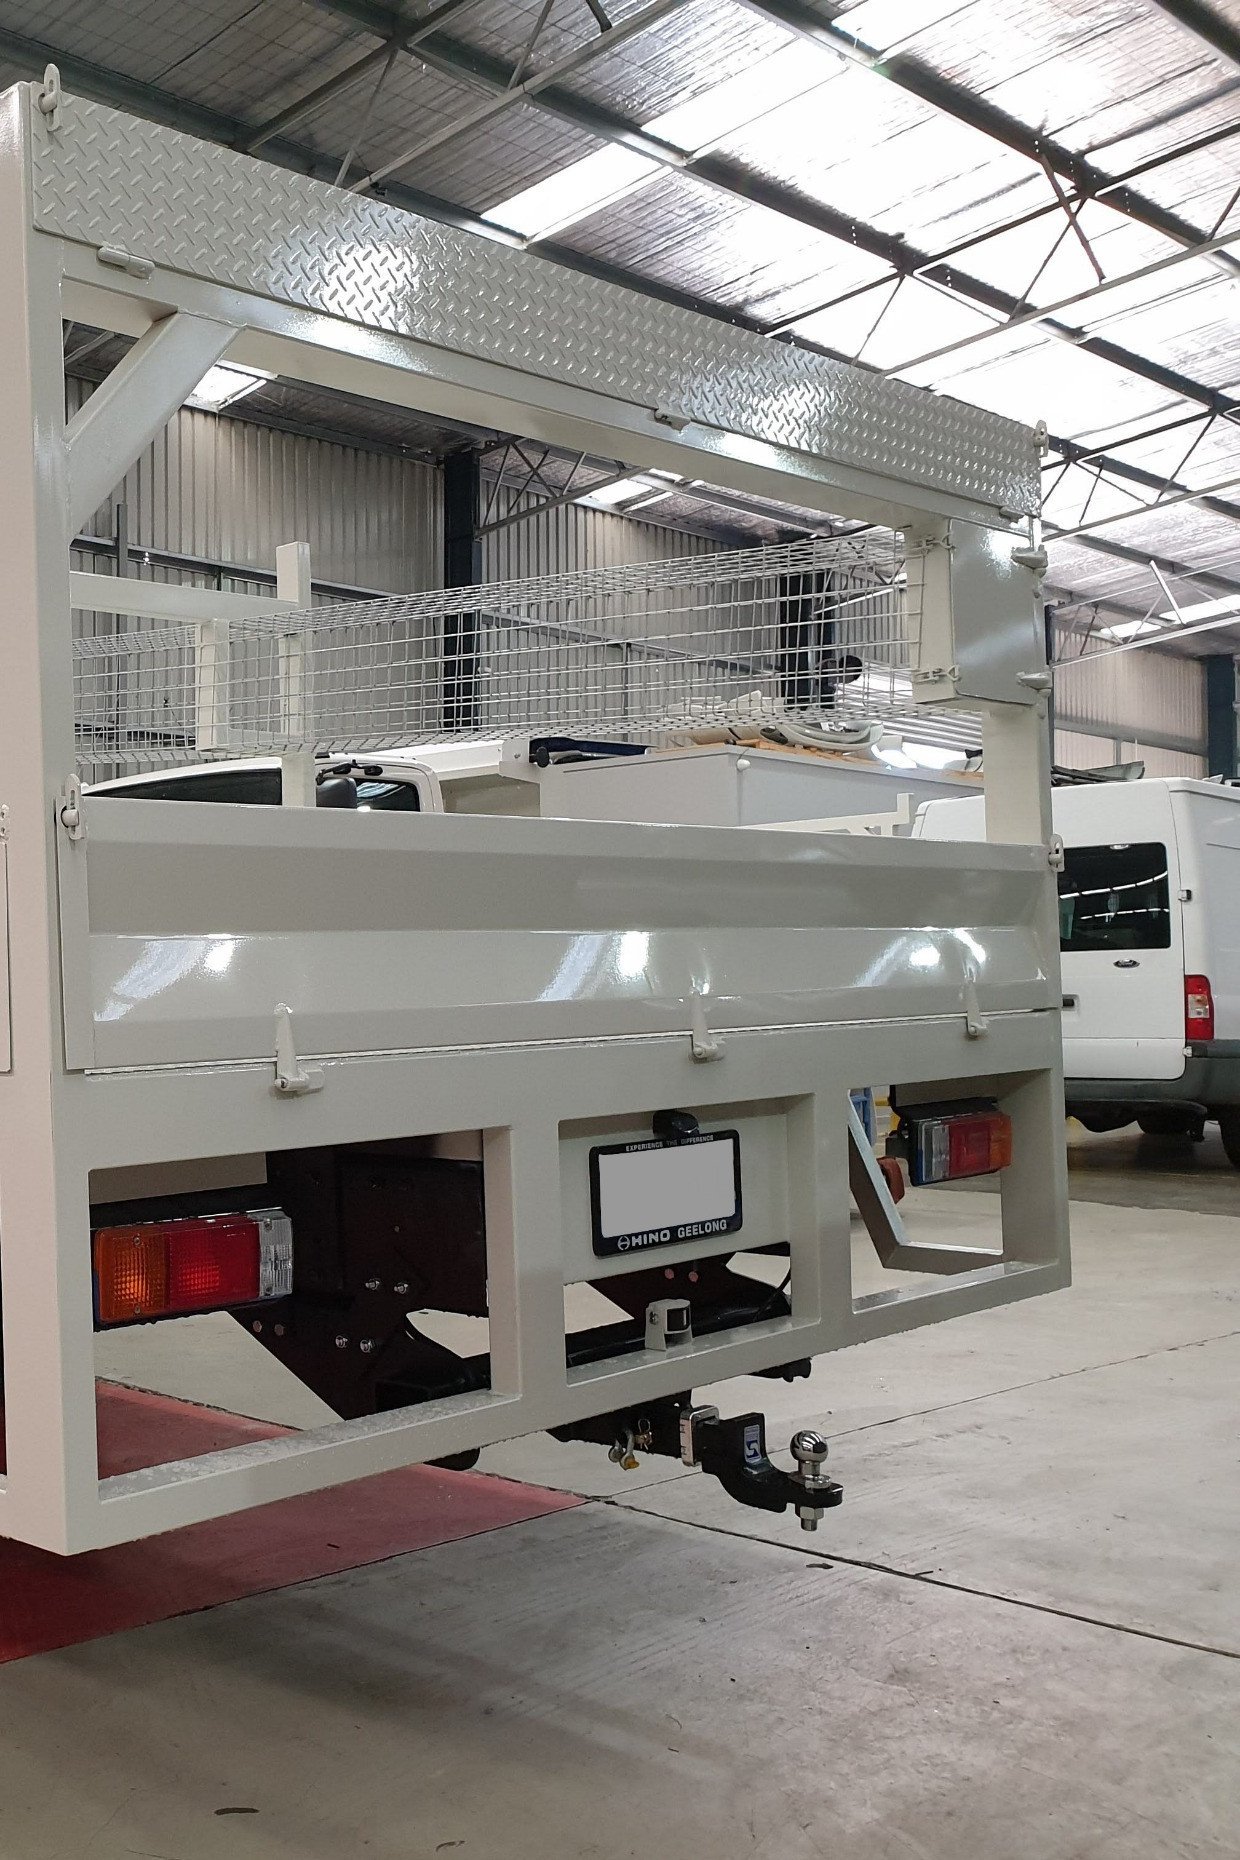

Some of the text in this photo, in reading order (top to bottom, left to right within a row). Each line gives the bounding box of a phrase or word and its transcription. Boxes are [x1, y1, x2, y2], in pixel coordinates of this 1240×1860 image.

[625, 1134, 714, 1152] EXPERIENCE THE DIFFERENCE
[632, 1219, 728, 1247] HINO GEELONG
